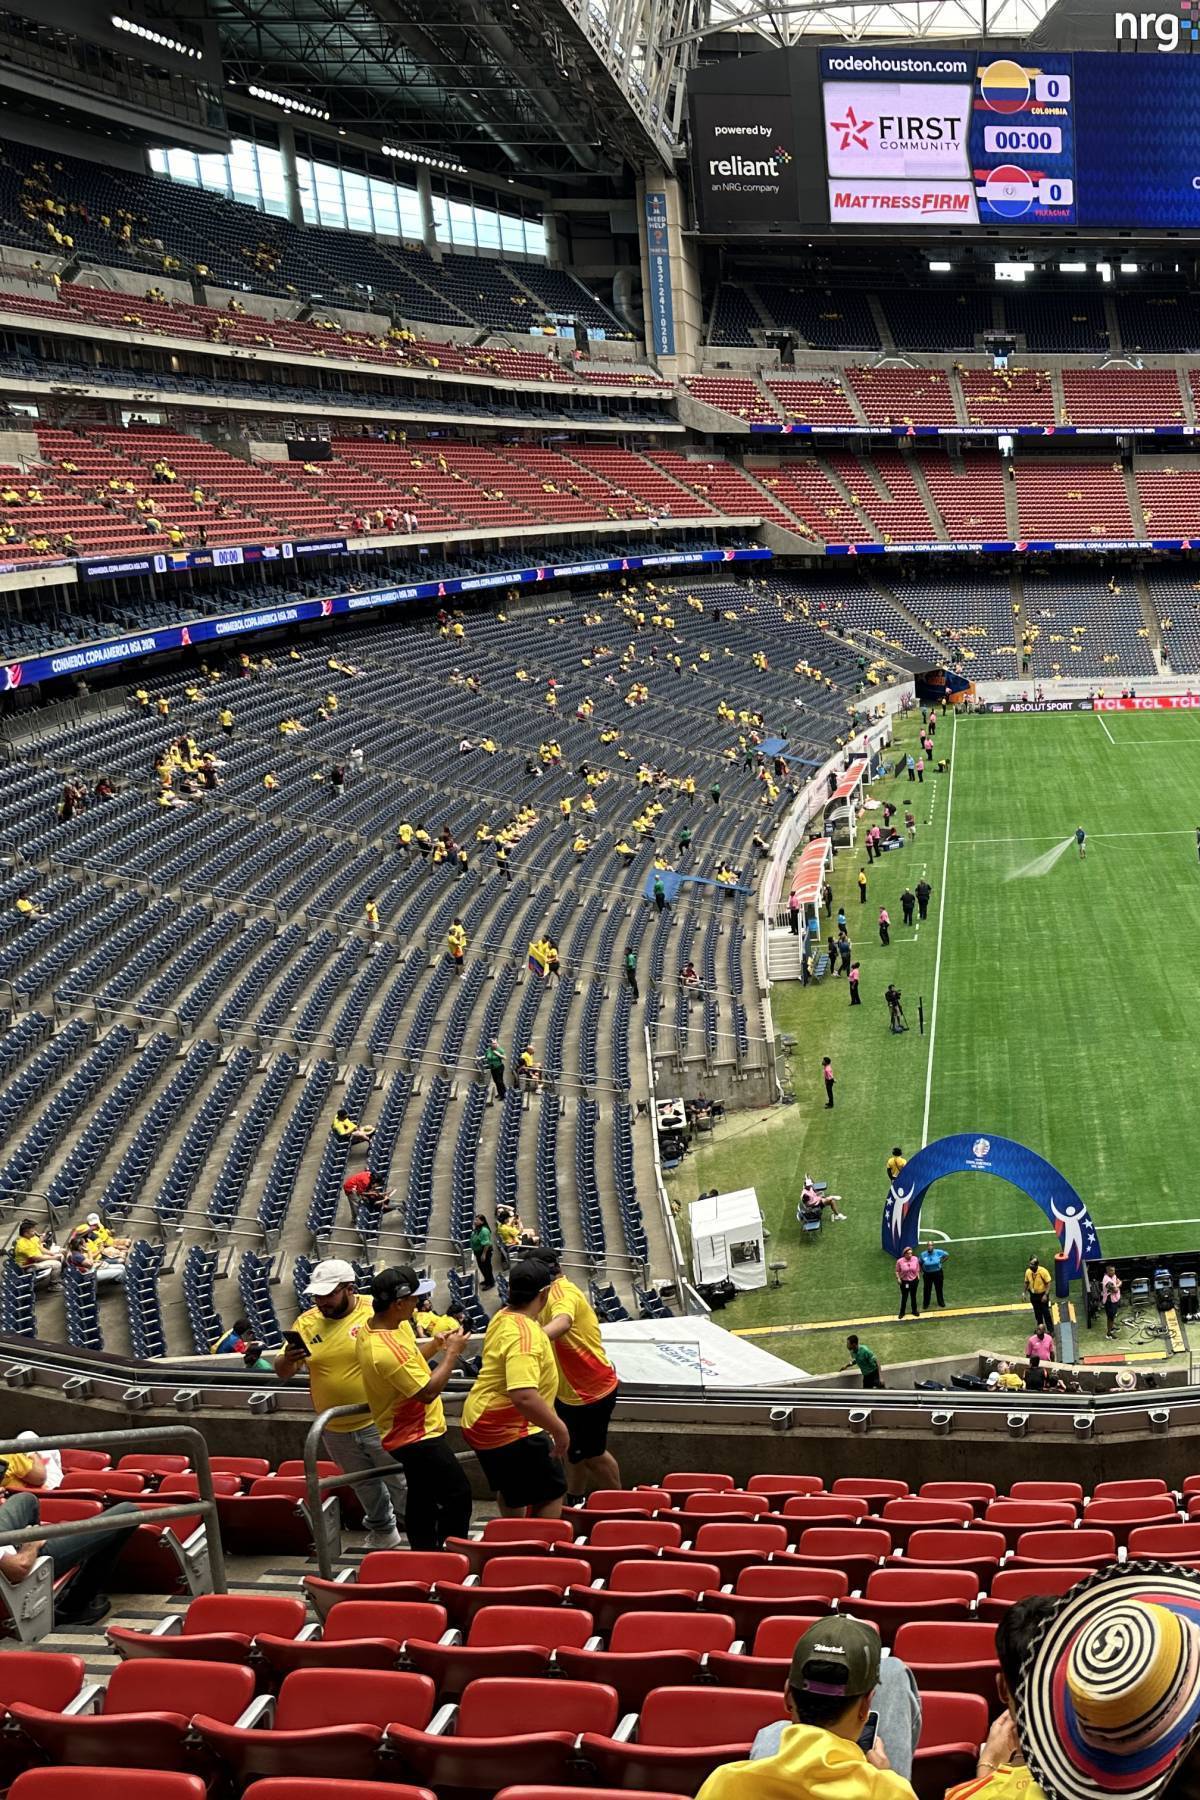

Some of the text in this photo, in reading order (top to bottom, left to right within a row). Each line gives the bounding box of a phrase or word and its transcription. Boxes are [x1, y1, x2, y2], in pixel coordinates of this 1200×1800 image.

[1115, 12, 1178, 52] nrg
[828, 56, 966, 72] rodeohouston.com
[1048, 80, 1059, 97] 0
[715, 125, 772, 137] powered by
[879, 116, 960, 140] FIRST
[880, 142, 960, 150] COMMUNITY
[996, 132, 1052, 149] 00:00
[709, 156, 779, 176] reliant
[742, 184, 779, 193] company
[1050, 184, 1061, 201] 0
[1010, 703, 1046, 712] ABSOLUT
[1047, 702, 1073, 710] SPORT
[1094, 700, 1125, 710] TCL
[1133, 698, 1162, 709] TCL
[1170, 696, 1199, 707] TCL
